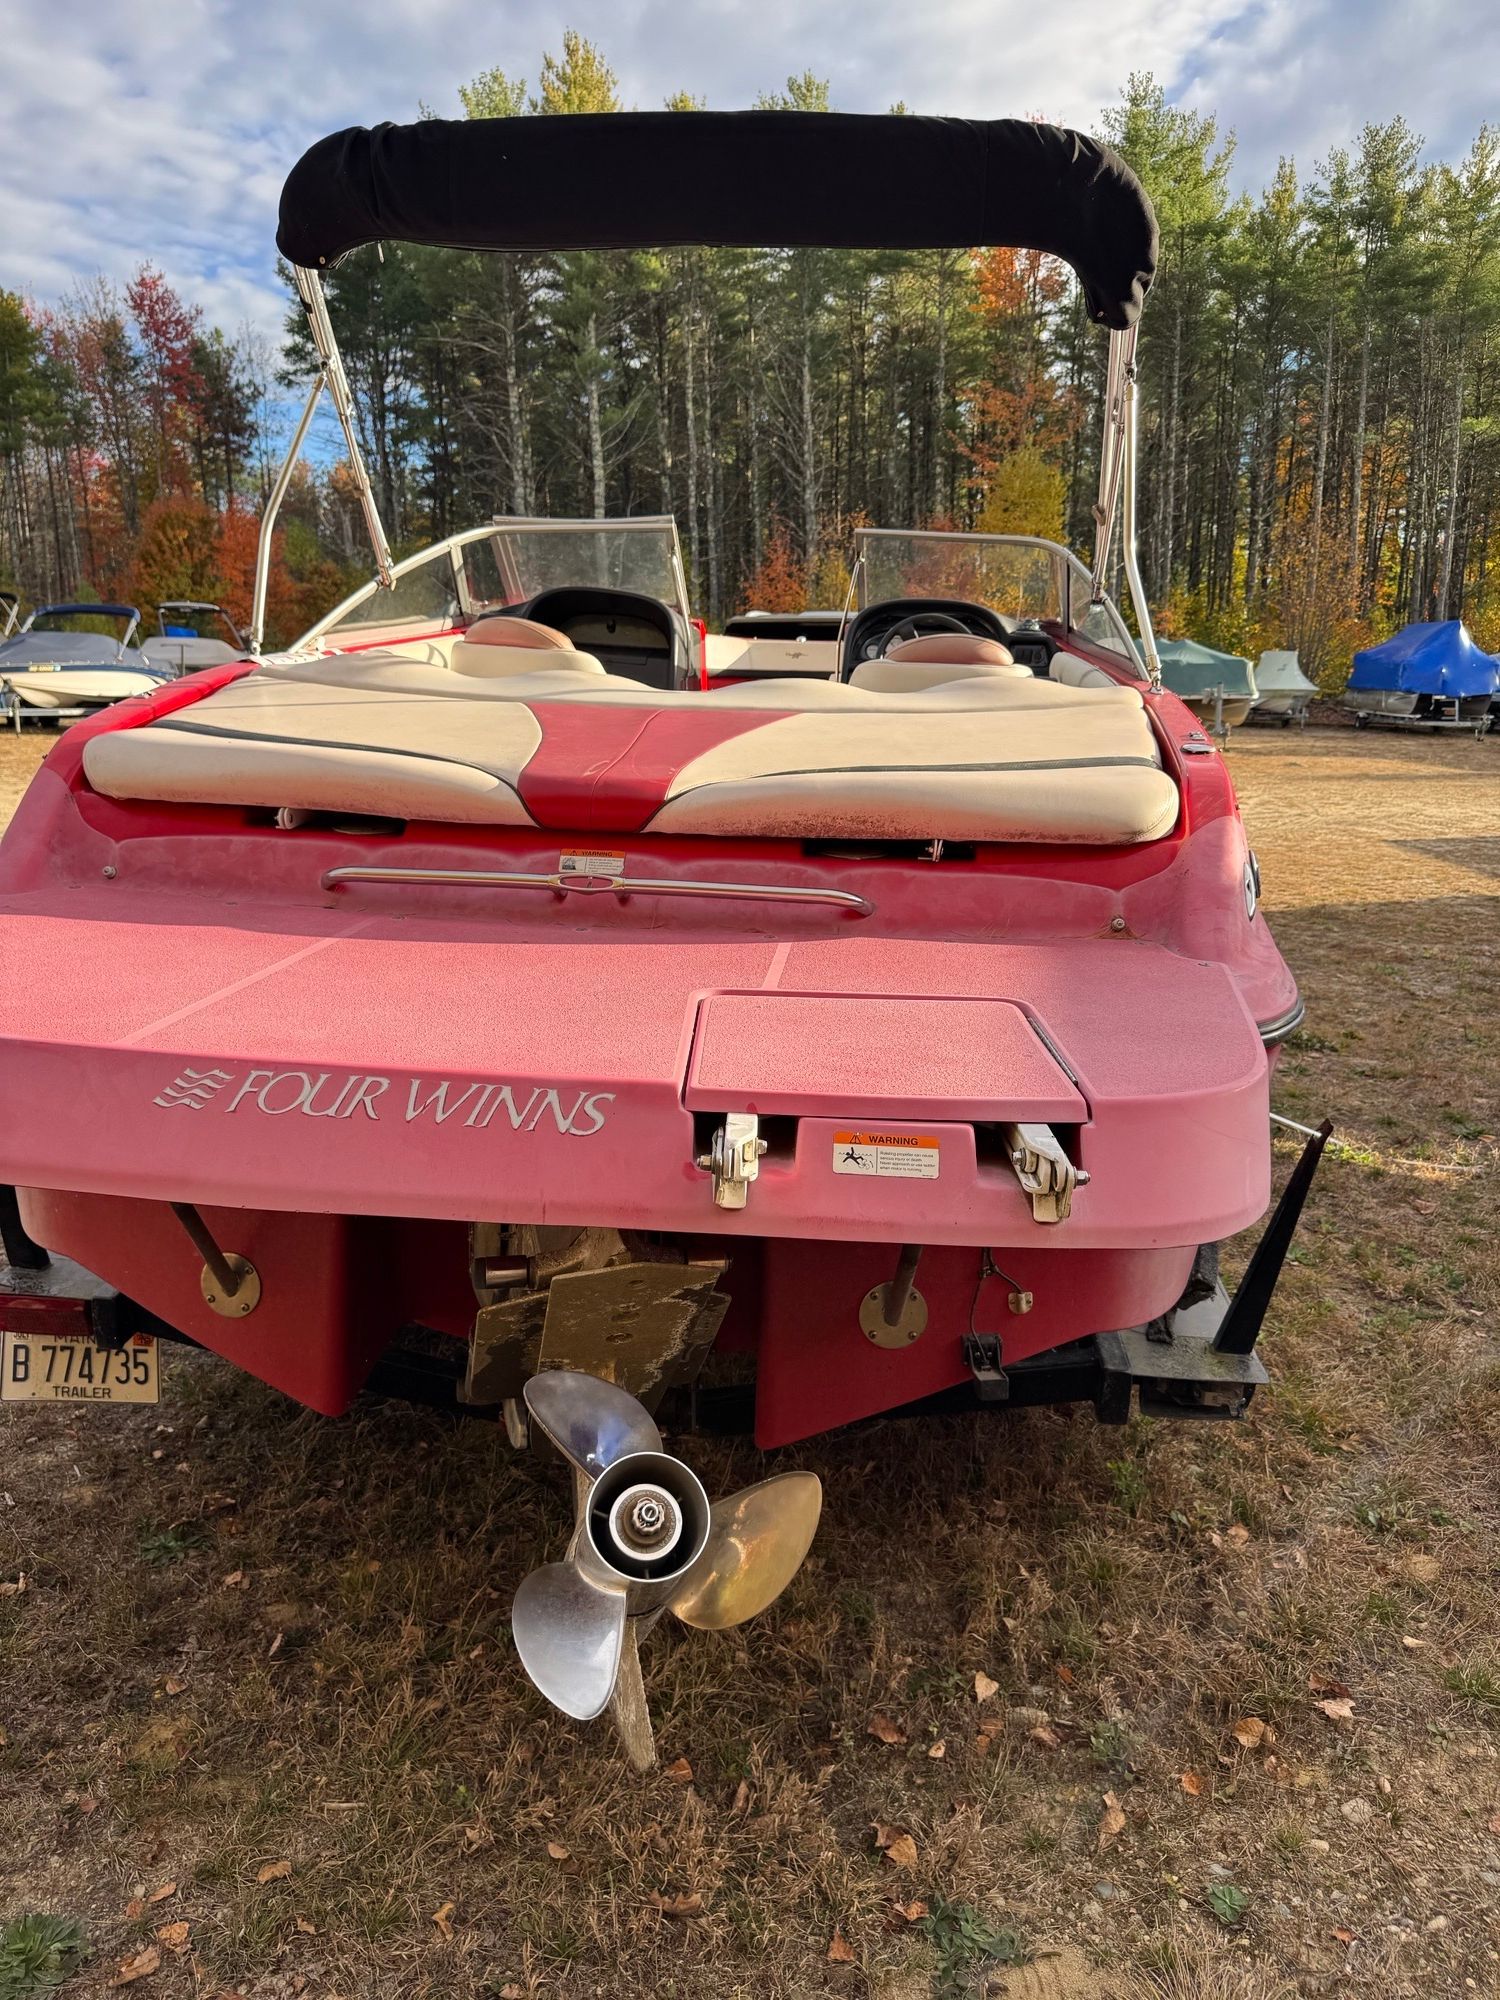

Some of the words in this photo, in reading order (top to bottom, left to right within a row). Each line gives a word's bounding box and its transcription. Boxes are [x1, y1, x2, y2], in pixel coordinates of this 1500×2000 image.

[224, 1070, 390, 1121] FOUR
[405, 1078, 616, 1137] WINNS
[869, 1136, 918, 1145] WARNING
[54, 1335, 98, 1345] MAIN
[12, 1344, 30, 1382] B
[42, 1345, 149, 1385] 774735
[52, 1385, 111, 1399] TRAILER
